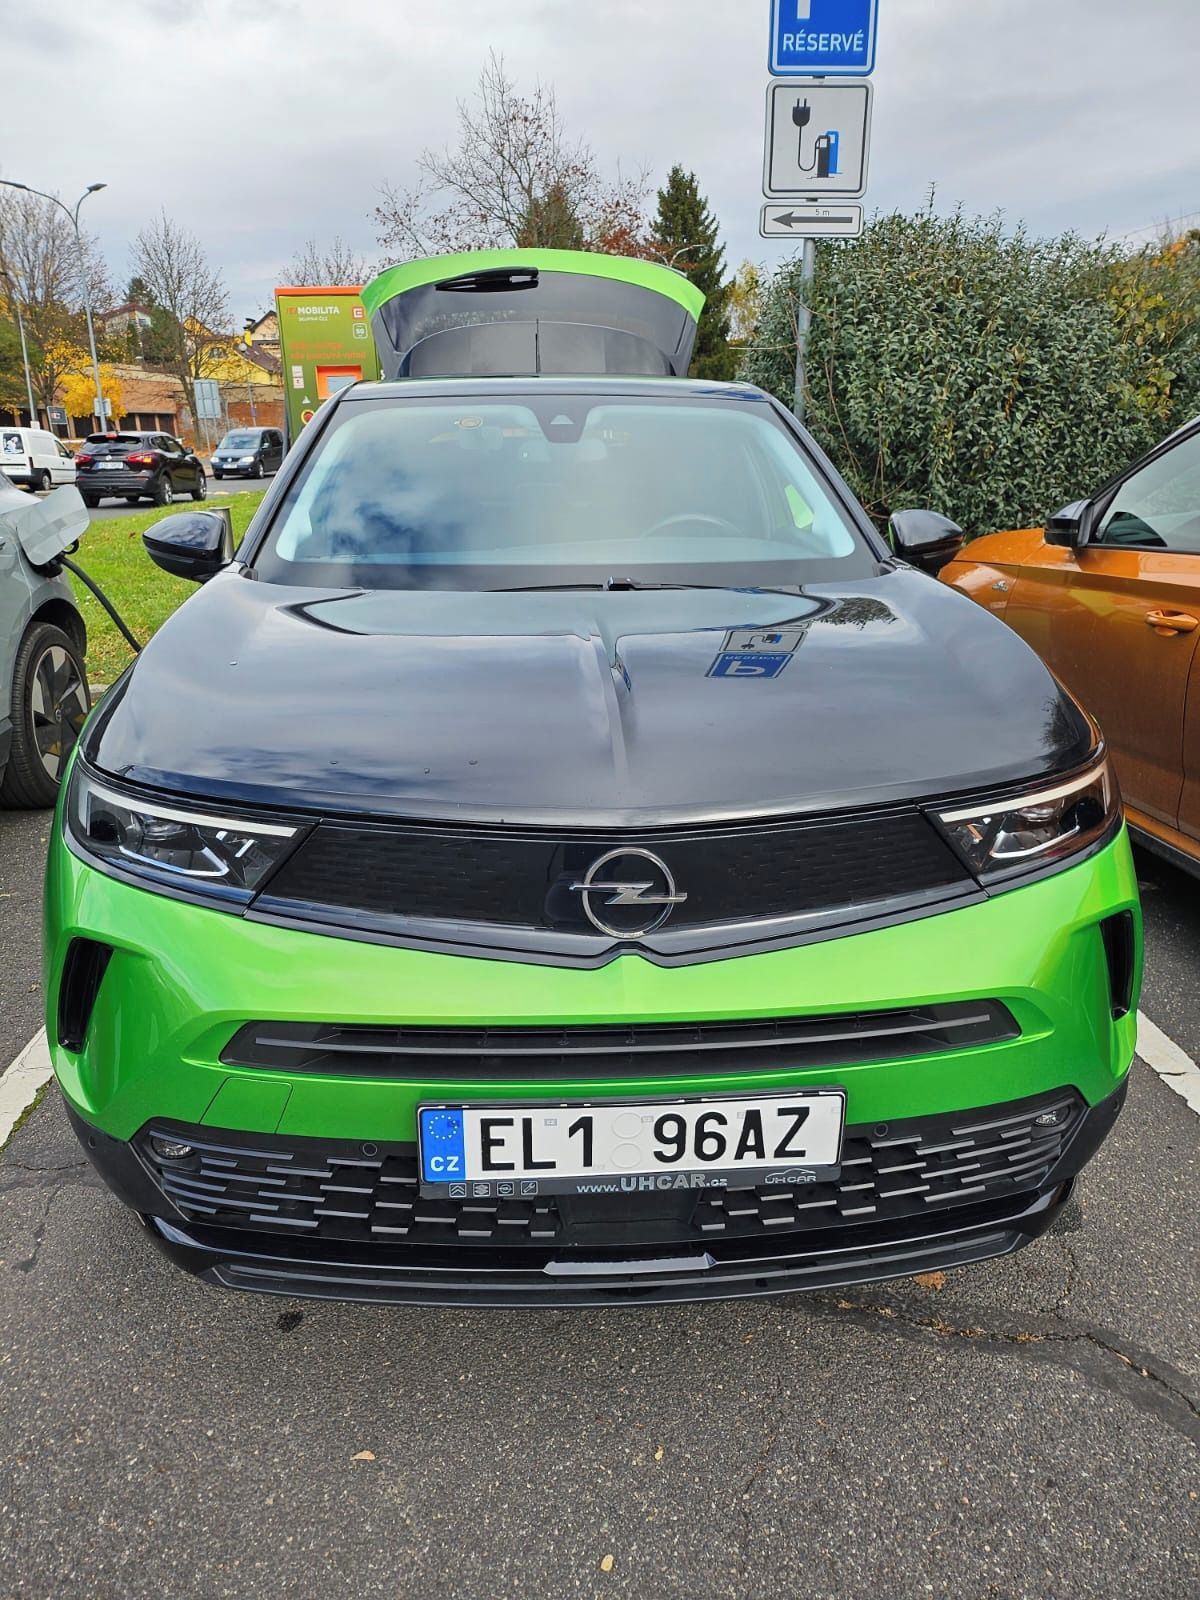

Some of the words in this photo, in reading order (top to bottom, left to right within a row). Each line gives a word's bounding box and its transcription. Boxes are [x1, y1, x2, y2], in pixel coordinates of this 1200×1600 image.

[782, 29, 865, 52] RÉSERVÉ
[815, 208, 820, 216] 5
[297, 306, 340, 315] MOBILITA
[480, 1116, 593, 1171] EL1
[653, 1106, 810, 1163] 96AZ
[430, 1156, 459, 1172] CZ
[576, 1173, 728, 1193] www.UHCAR.cz
[764, 1174, 817, 1185] UHCAR
